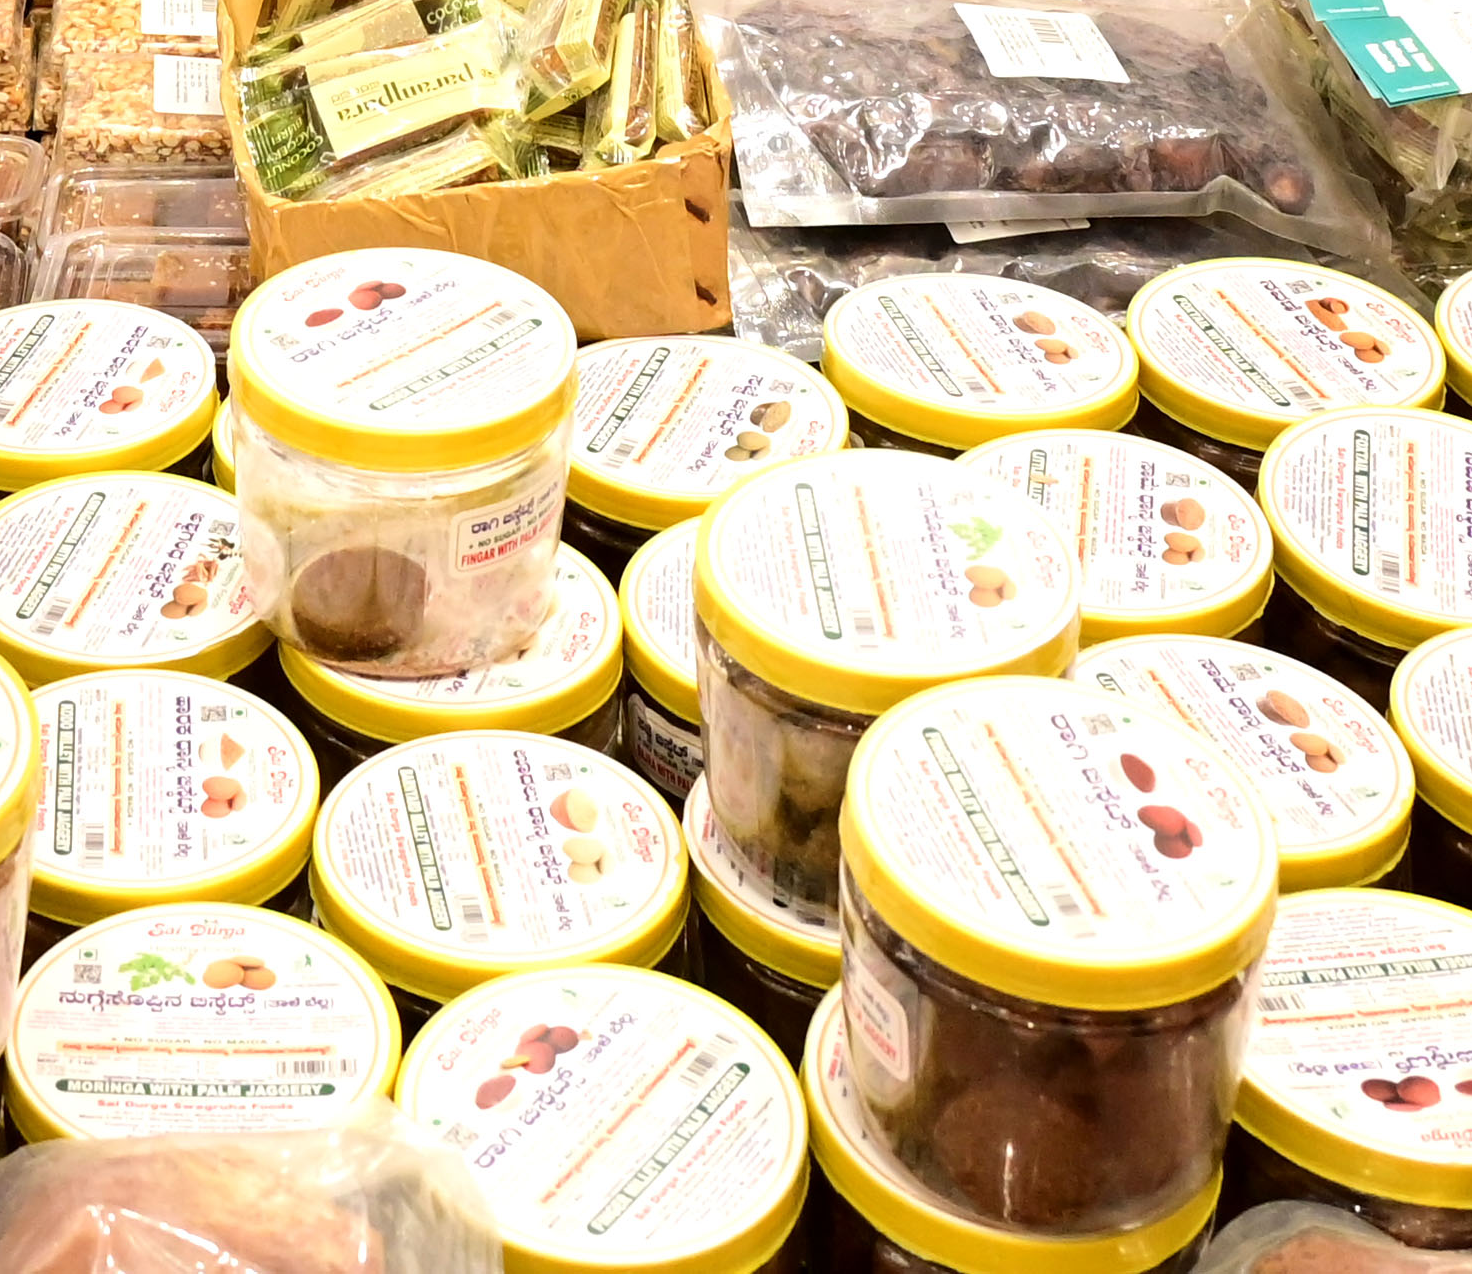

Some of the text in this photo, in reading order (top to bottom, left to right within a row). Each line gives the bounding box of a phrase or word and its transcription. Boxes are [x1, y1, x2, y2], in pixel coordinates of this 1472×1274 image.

[1350, 431, 1371, 572] FOXTAIL WITH PALM JAGGERY
[460, 548, 495, 568] FINGAR
[497, 538, 518, 557] WITH
[148, 918, 246, 938] Sai Durga
[68, 1079, 322, 1097] MORINGA WITH PALM JAGGERY
